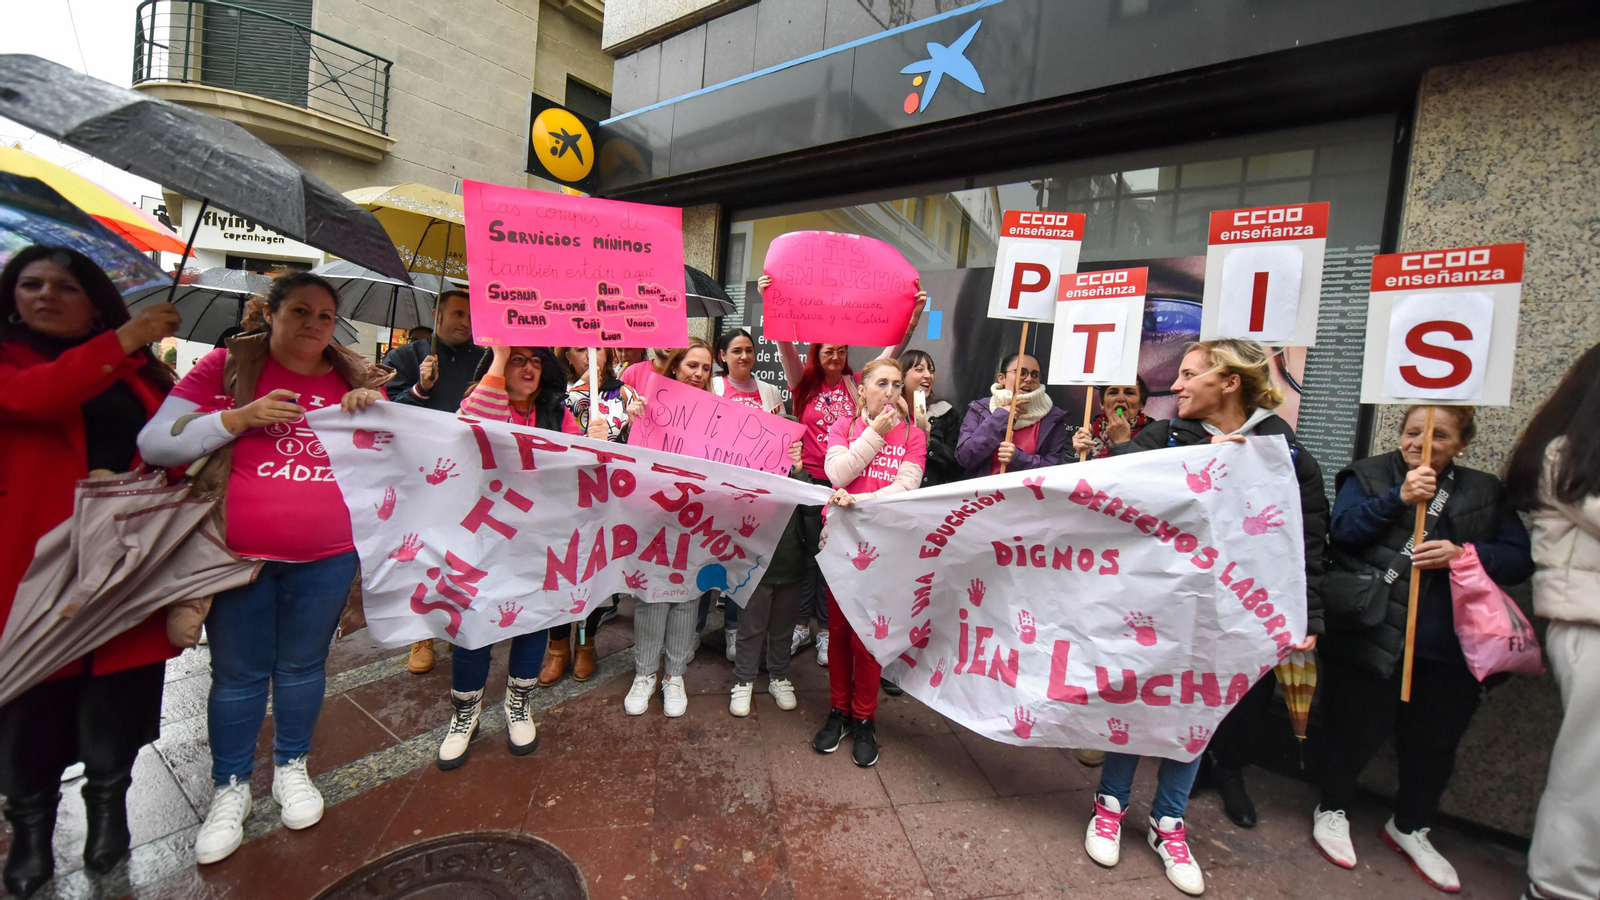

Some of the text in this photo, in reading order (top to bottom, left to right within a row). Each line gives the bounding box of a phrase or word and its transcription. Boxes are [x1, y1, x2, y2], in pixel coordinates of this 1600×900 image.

[479, 187, 647, 231] Las compis de
[1019, 213, 1068, 226] CCOO
[1233, 207, 1303, 226] CCOO
[223, 232, 285, 244] copenhagen
[1009, 225, 1075, 238] enseñanza
[1220, 224, 1315, 241] enseñanza
[487, 249, 559, 279] también
[566, 257, 616, 279] están
[1401, 249, 1490, 271] CCOO
[780, 263, 906, 294] EN LUCHA
[1008, 262, 1052, 310] P
[1076, 271, 1128, 286] CCOO
[1385, 268, 1505, 288] enseñanza
[769, 289, 794, 307] Por
[799, 297, 824, 307] una
[1066, 283, 1136, 298] enseñanza
[1249, 271, 1270, 332] I
[757, 350, 771, 362] de
[1073, 323, 1116, 374] T
[1399, 320, 1473, 389] S
[257, 459, 337, 482] CÁDIZ
[577, 465, 636, 508] NO
[650, 482, 746, 562] SOMOS
[1427, 489, 1449, 517] BIMBA
[911, 571, 935, 618] UNA
[1022, 475, 1046, 501] Y
[1068, 479, 1219, 570] DERECHOS
